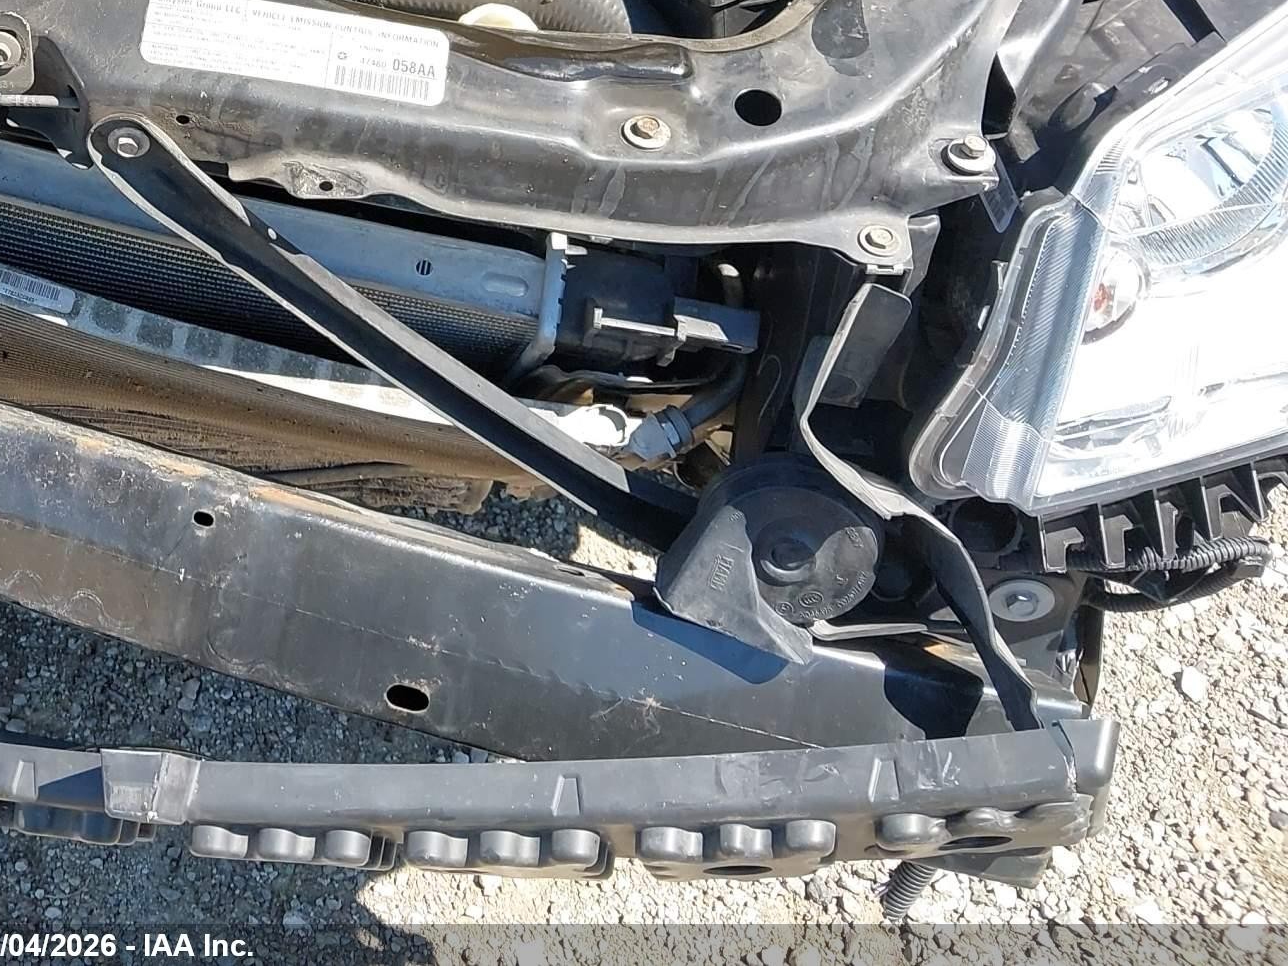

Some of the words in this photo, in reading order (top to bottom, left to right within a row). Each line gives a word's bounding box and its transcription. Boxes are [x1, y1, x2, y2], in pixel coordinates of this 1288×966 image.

[290, 14, 333, 30] EMISSION
[377, 30, 441, 49] INFORMATION
[392, 57, 436, 79] 058AA
